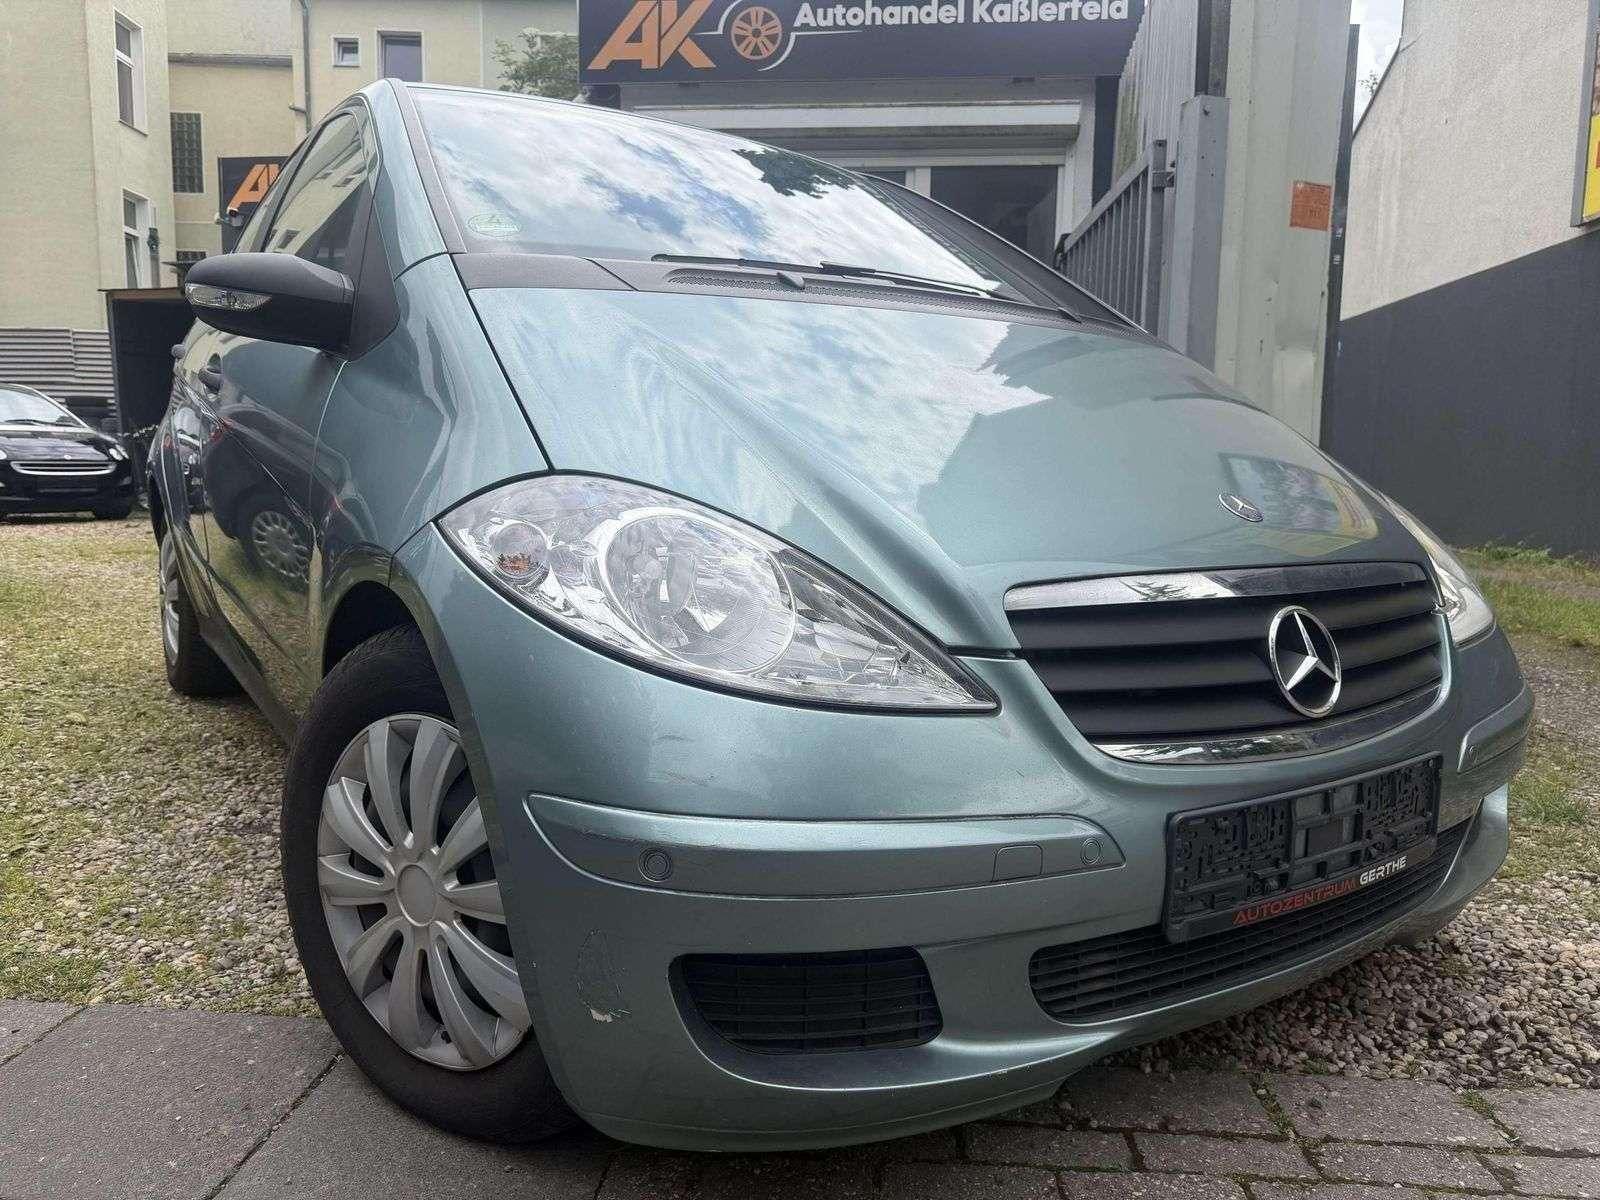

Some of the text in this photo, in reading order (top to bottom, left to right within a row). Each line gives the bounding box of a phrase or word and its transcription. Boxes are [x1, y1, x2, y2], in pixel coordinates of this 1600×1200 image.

[586, 0, 717, 70] AK
[793, 0, 1129, 27] Autohandel Kaßlerfeld
[1232, 855, 1408, 926] AUTOZENTRUM GERTHE
